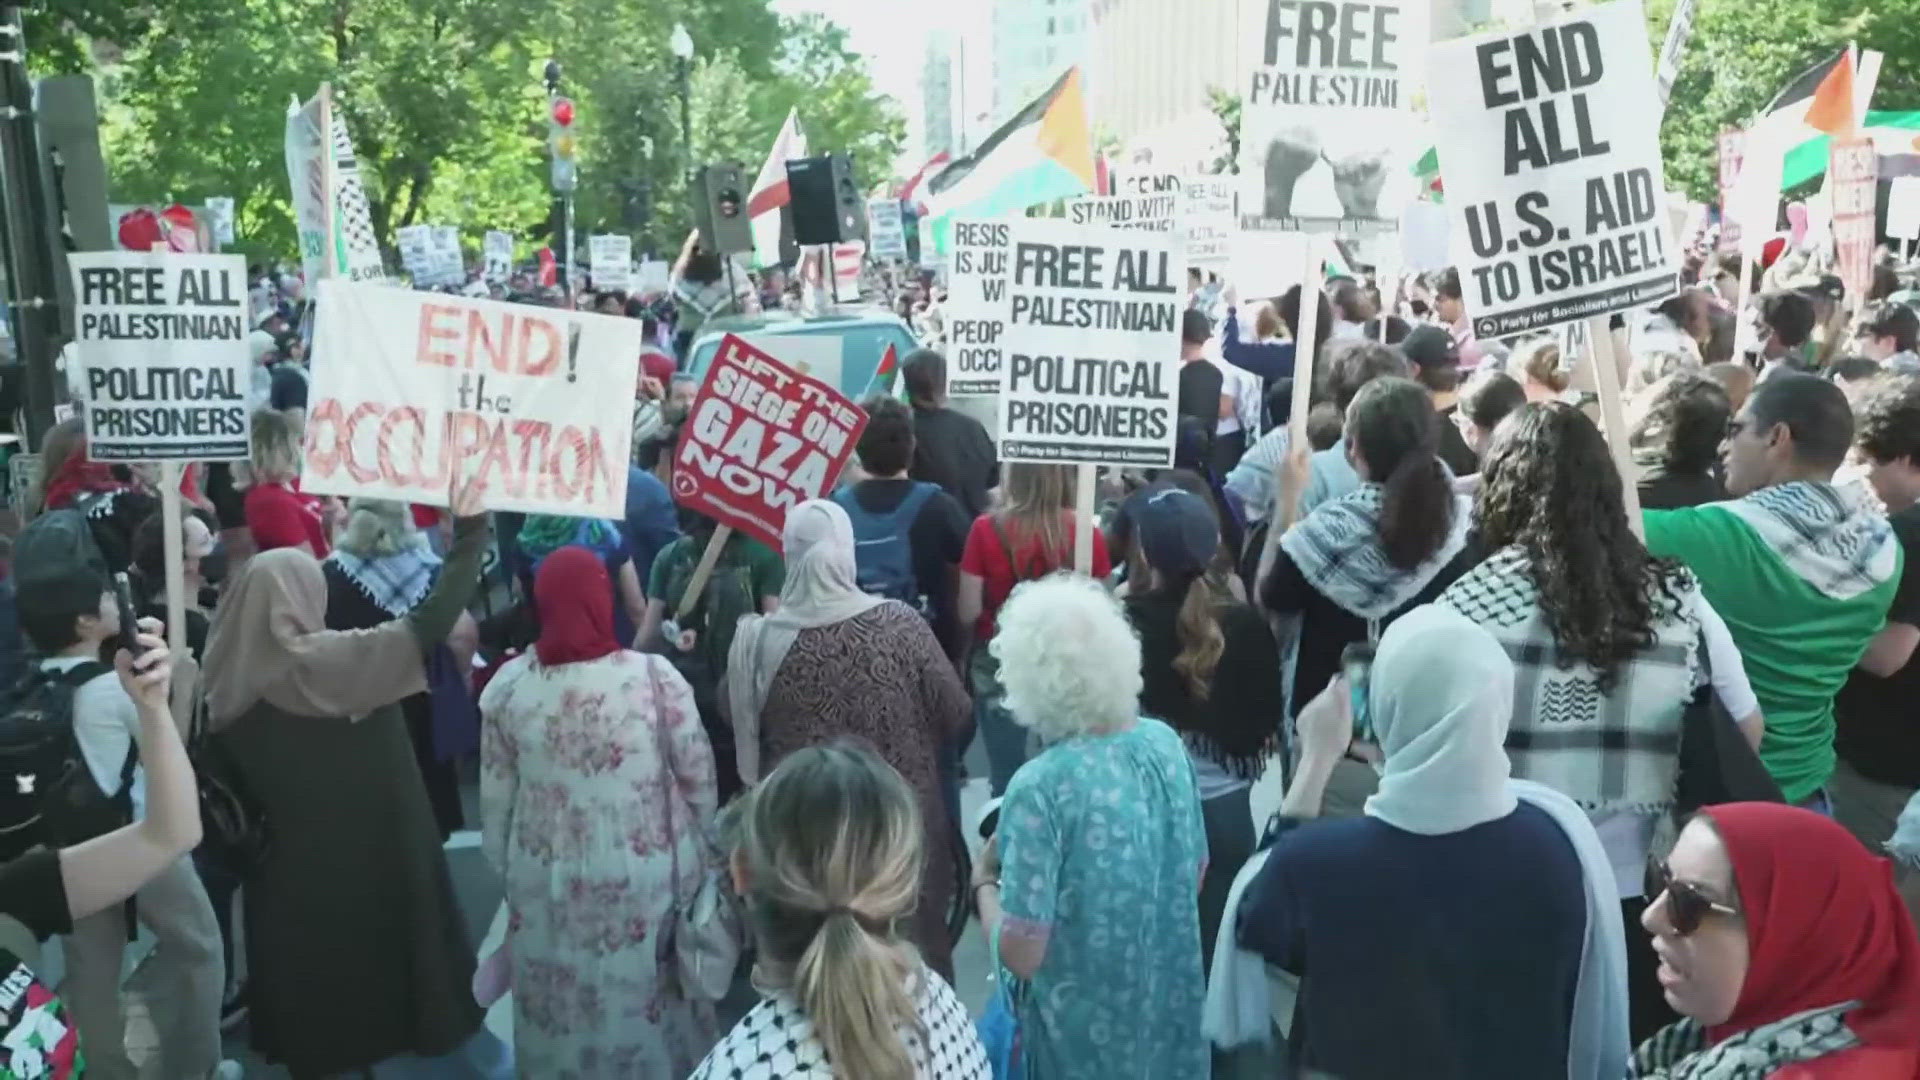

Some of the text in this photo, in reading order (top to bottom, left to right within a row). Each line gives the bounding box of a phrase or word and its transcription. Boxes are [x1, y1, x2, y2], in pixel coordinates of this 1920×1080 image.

[1264, 0, 1399, 70] FREE
[1475, 20, 1604, 110] END
[1504, 93, 1610, 176] ALL
[1071, 199, 1132, 224] STAND
[1464, 167, 1656, 258] U.S. AID
[80, 267, 240, 307] FREE ALL
[955, 251, 972, 274] IS
[1014, 241, 1177, 293] FREE ALL
[1472, 226, 1666, 307] TO ISRAEL!
[82, 313, 242, 340] PALESTINIAN
[1011, 295, 1175, 333] PALESTINIAN
[1501, 316, 1531, 334] Party
[1533, 310, 1549, 324] for
[416, 303, 582, 382] END!
[87, 367, 243, 401] POLITICAL
[458, 372, 511, 414] the
[726, 345, 859, 430] LIFT THE
[1010, 354, 1169, 400] POLITICAL
[91, 407, 244, 437] PRISONERS
[713, 365, 849, 459] SIEGE ON
[1007, 400, 1168, 440] PRISONERS
[306, 398, 615, 504] OCCUPATION
[693, 397, 829, 500] GAZA
